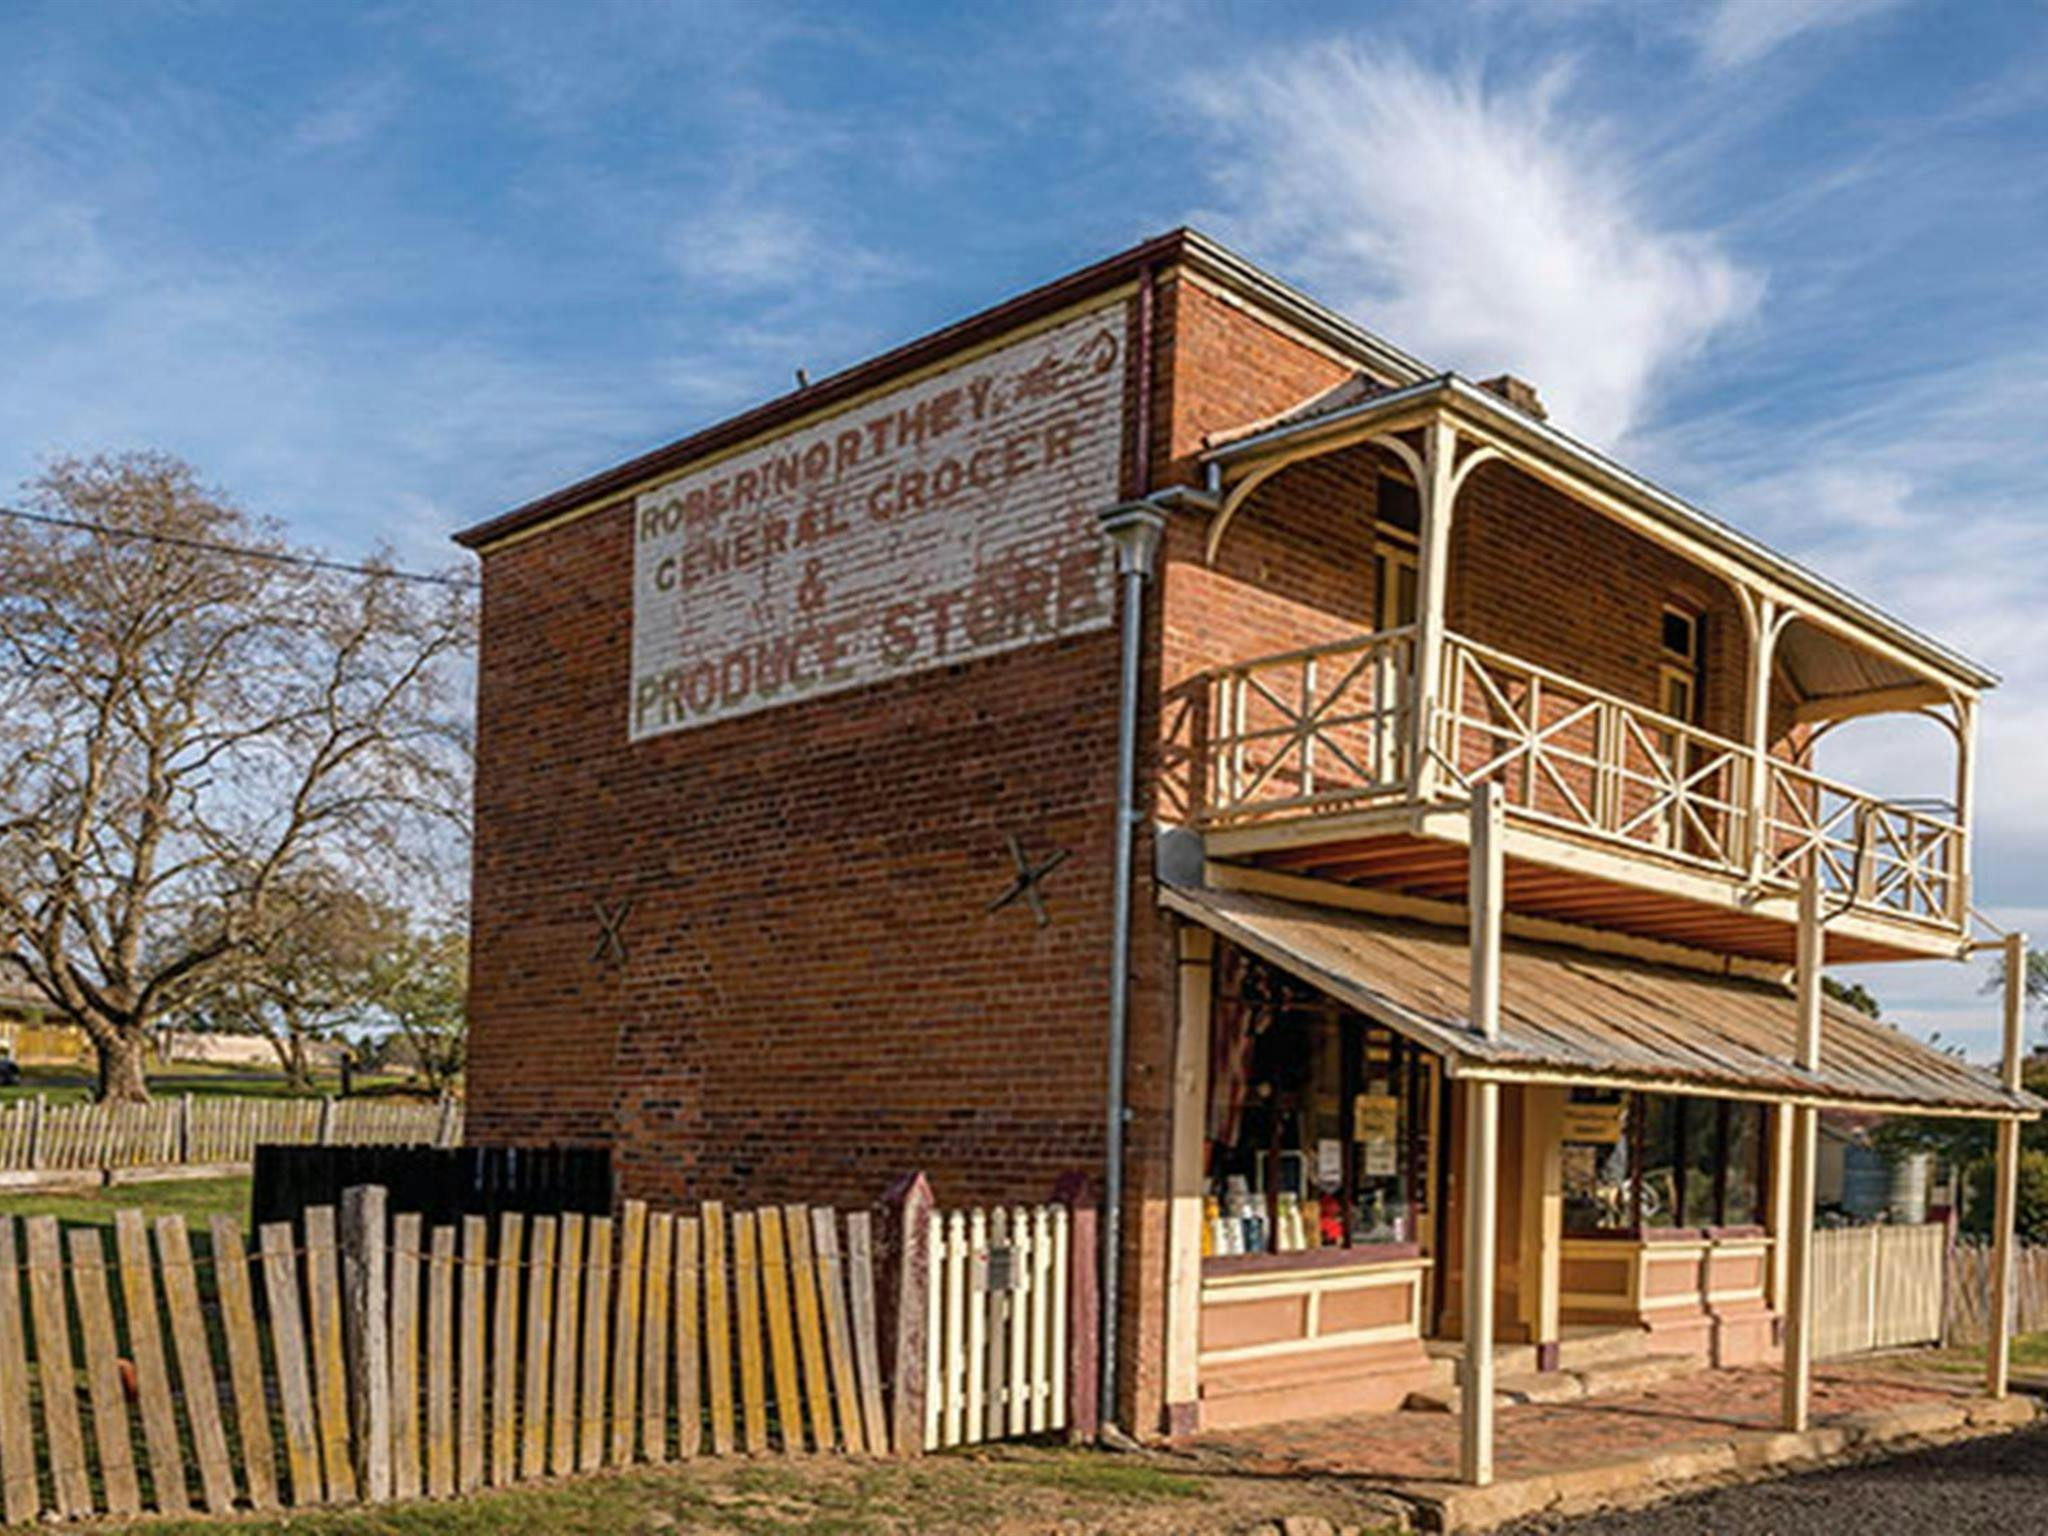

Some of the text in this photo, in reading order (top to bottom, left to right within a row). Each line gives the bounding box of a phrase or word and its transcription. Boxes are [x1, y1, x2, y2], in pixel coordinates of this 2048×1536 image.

[654, 418, 1080, 593] GENERAL GROCER
[797, 556, 829, 613] &
[636, 548, 1112, 731] PRODUCE STORE
